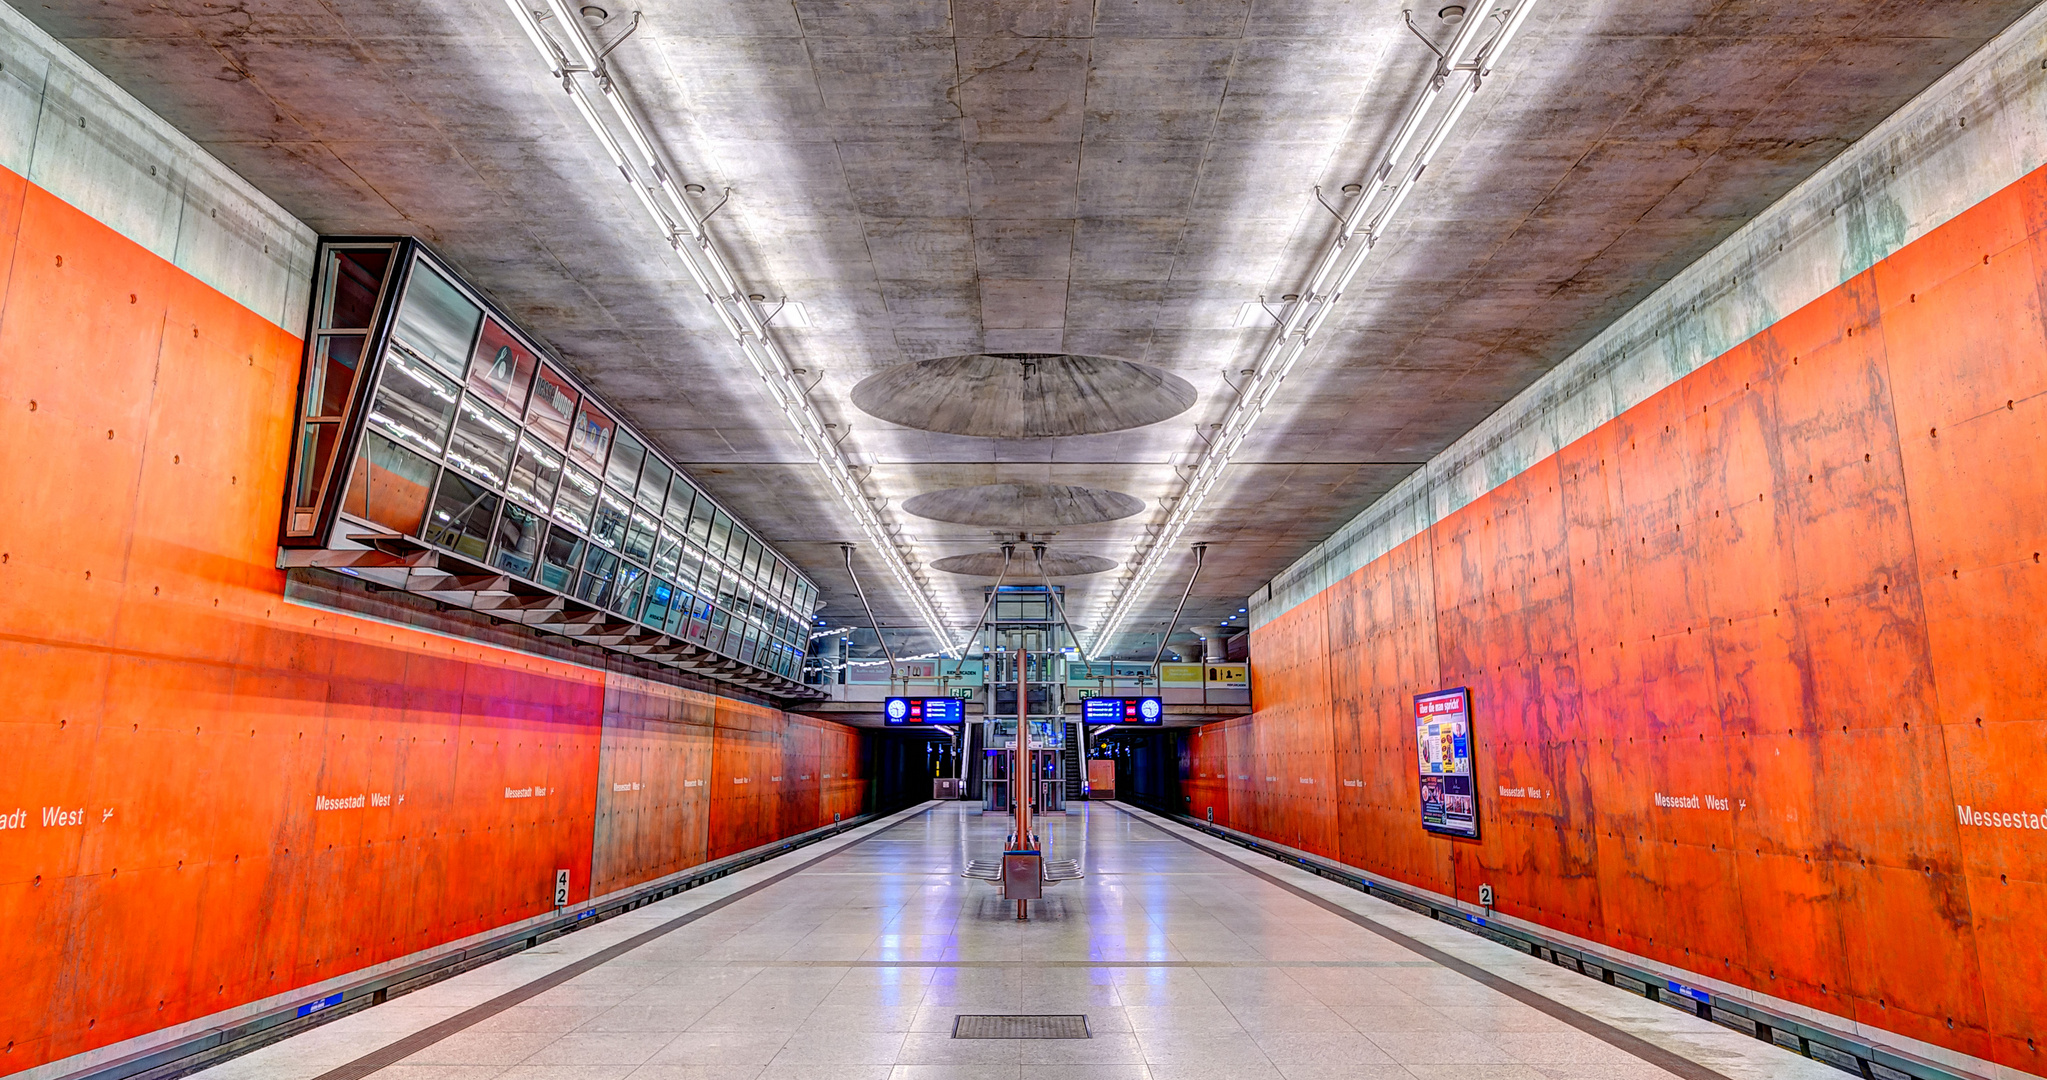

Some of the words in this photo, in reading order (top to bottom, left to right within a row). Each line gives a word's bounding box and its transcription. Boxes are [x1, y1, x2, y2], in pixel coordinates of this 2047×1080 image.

[504, 787, 532, 799] Messestadt
[534, 786, 546, 797] West
[1499, 785, 1526, 798] Messestadt
[1527, 786, 1542, 799] West
[315, 793, 366, 811] Messestadt
[371, 792, 391, 807] West
[1654, 792, 1700, 809] Messestadt
[1704, 794, 1730, 811] West
[42, 806, 84, 827] West
[559, 872, 567, 885] 4
[557, 889, 566, 903] 2
[1481, 888, 1491, 902] 2
